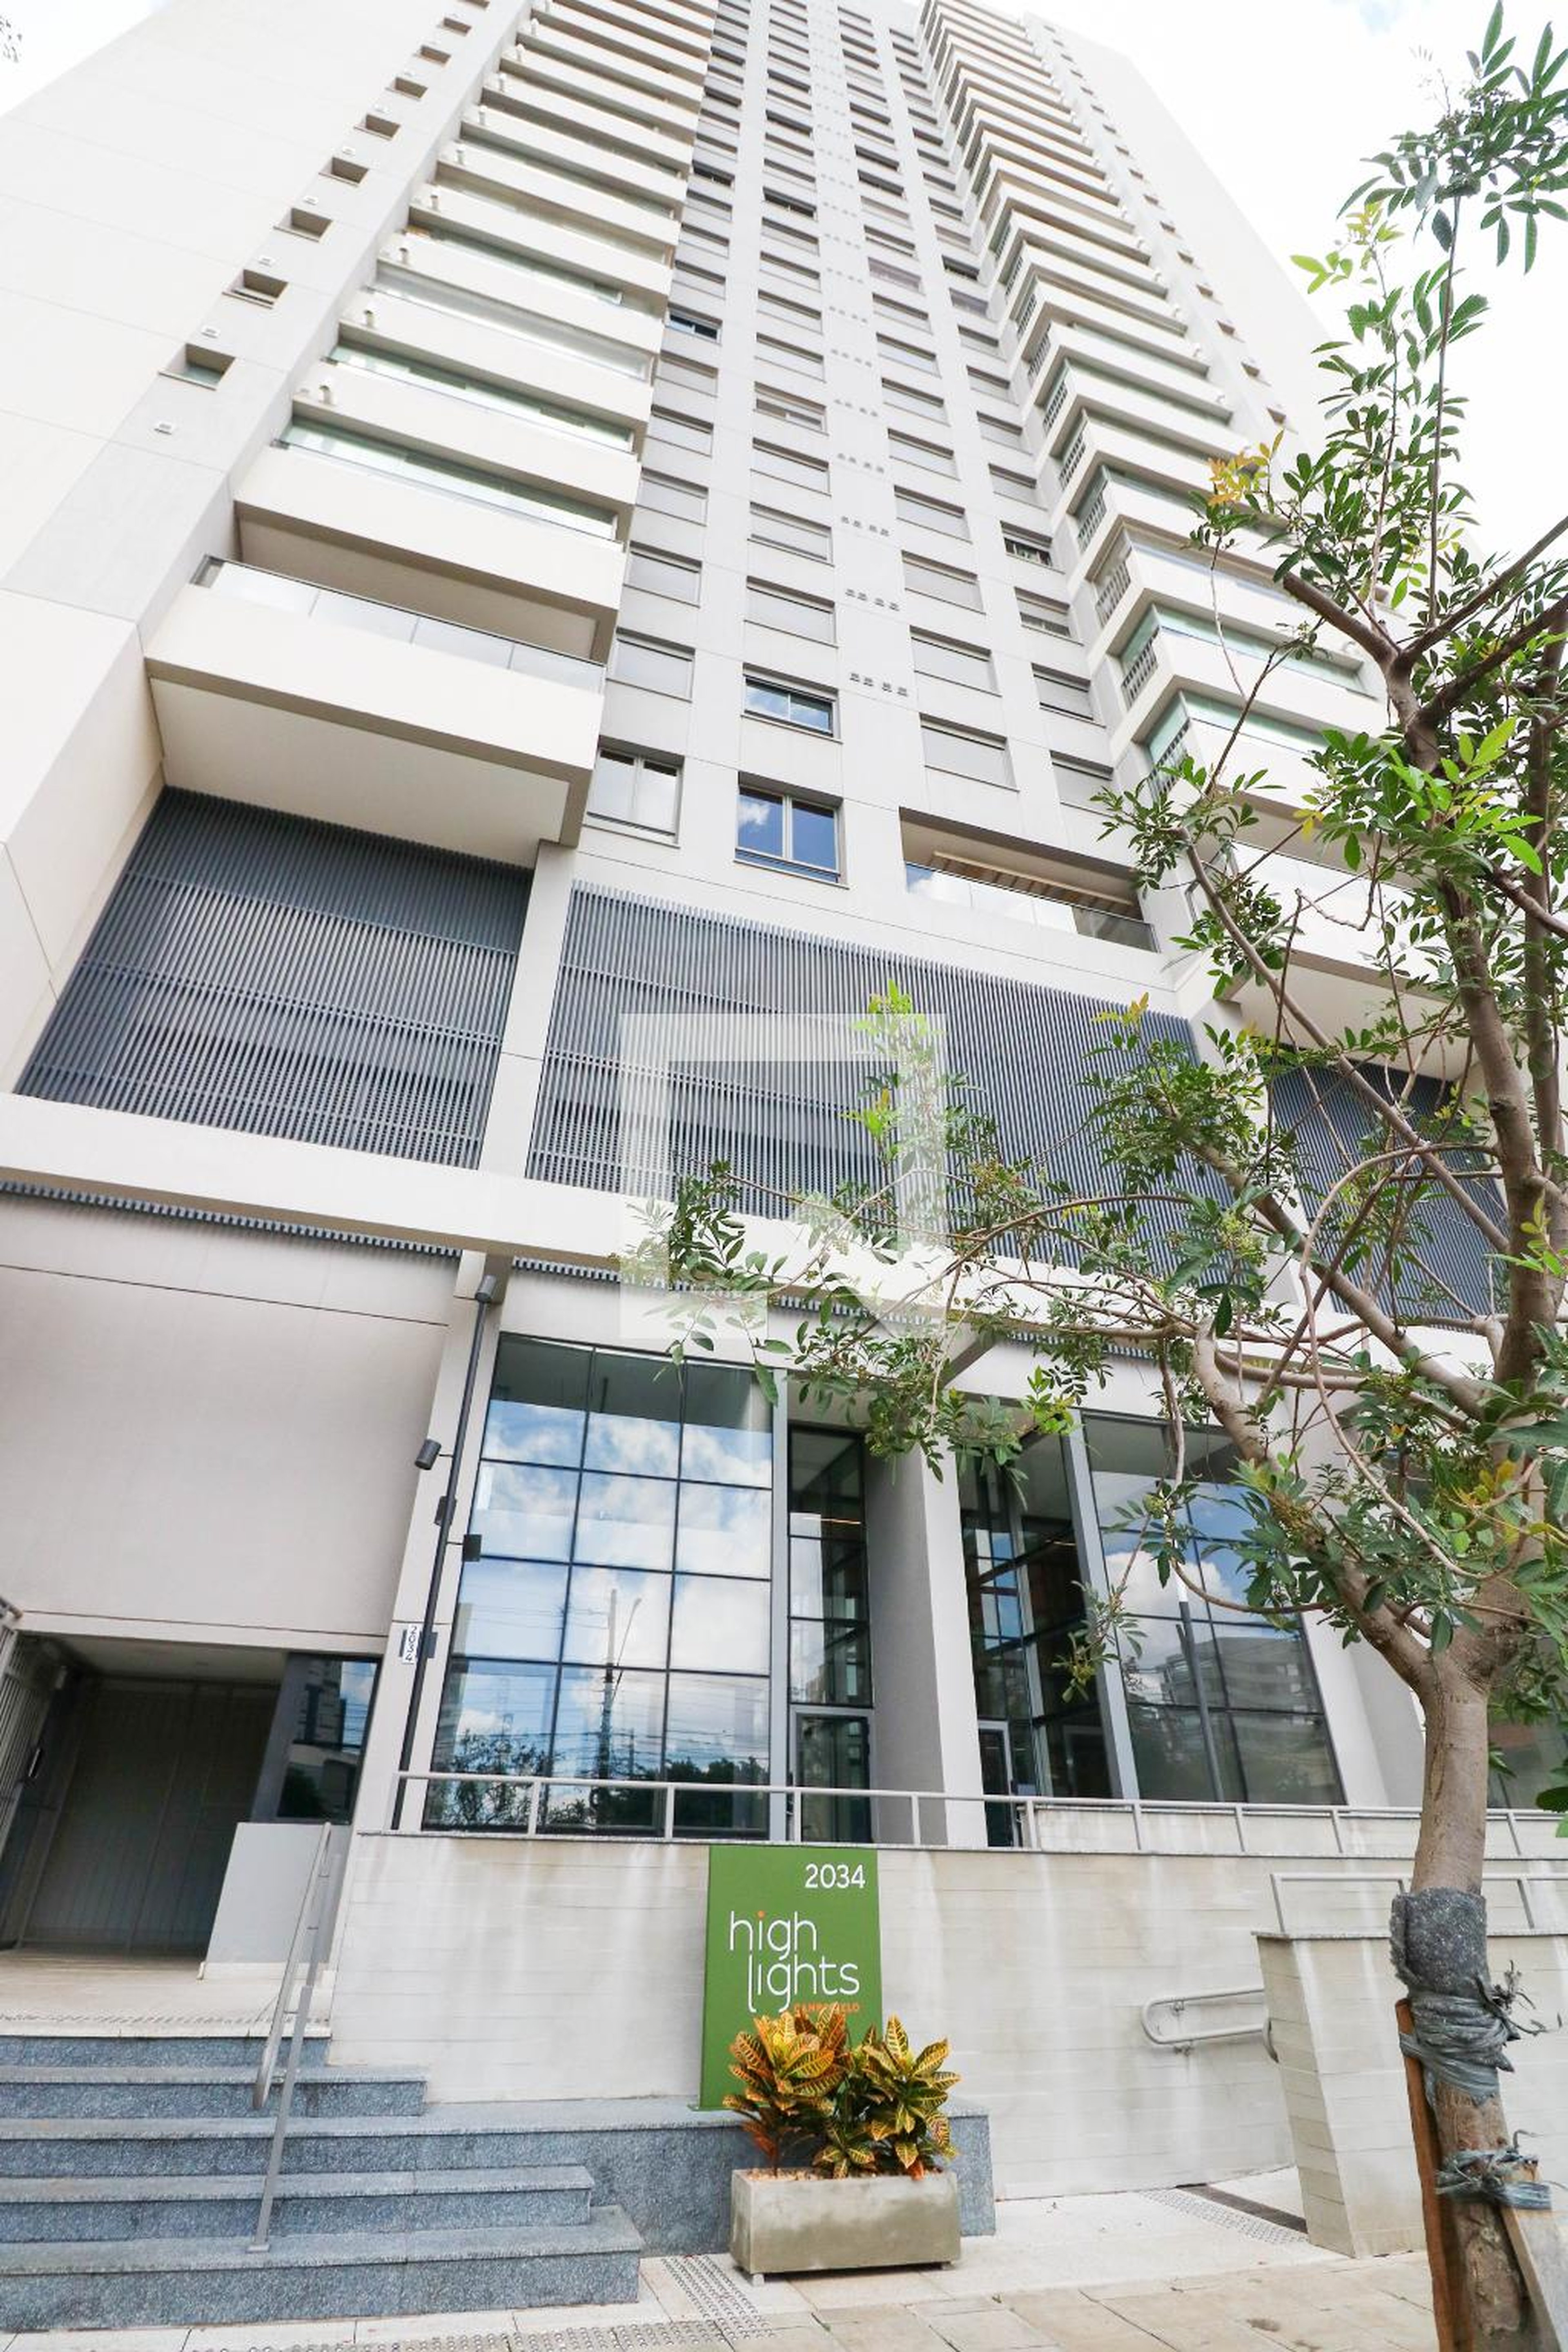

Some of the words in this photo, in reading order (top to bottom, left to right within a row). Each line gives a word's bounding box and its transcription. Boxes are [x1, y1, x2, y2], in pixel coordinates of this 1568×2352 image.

[405, 1626, 417, 1661] 2034
[805, 1864, 865, 1888] 2034
[729, 1911, 817, 1961] high
[747, 1954, 860, 2013] lights
